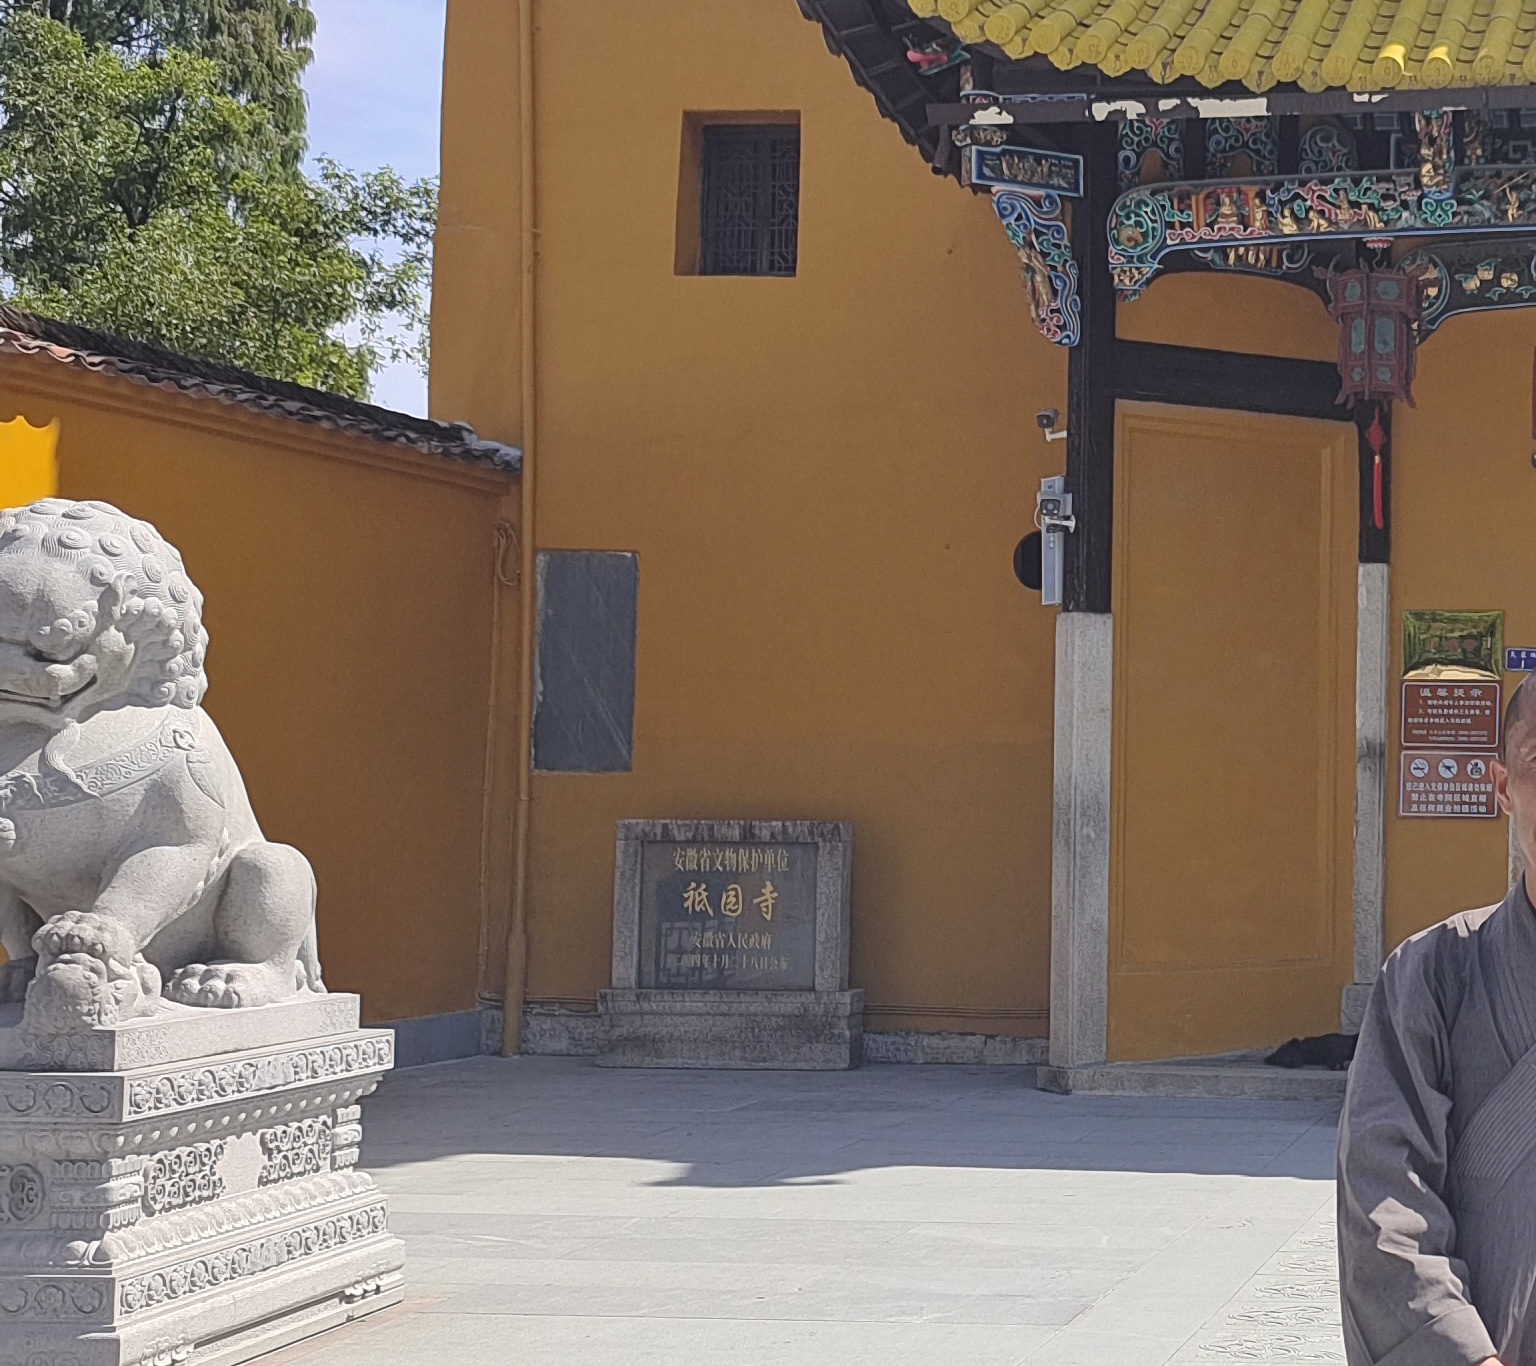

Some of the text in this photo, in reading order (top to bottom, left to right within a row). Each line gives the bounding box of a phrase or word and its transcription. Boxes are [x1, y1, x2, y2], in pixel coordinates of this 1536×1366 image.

[672, 847, 790, 873] 安徽省文物保护单位
[690, 930, 773, 951] 安徽省人民政府
